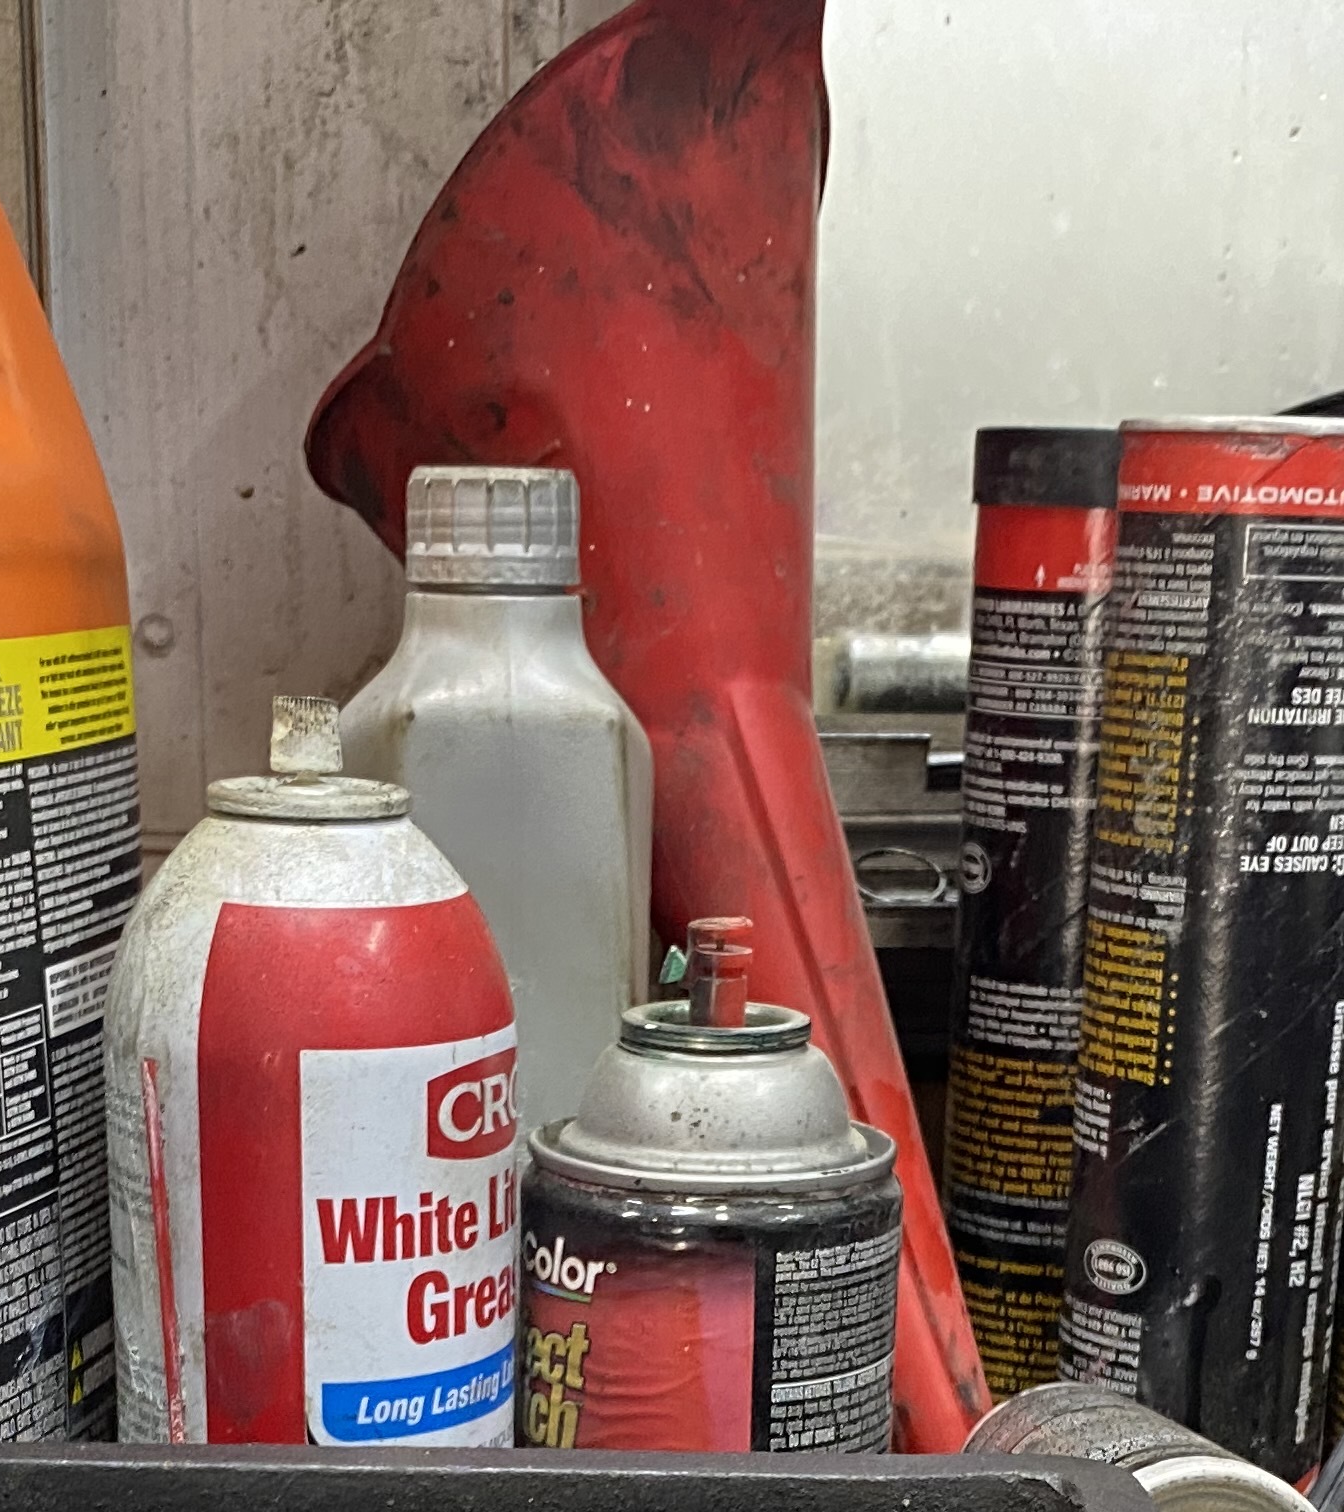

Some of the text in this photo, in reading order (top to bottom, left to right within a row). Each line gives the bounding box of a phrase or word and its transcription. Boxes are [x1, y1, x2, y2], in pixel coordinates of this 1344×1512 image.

[1248, 707, 1332, 725] IRRITATION
[1264, 833, 1319, 852] OUT OF
[1239, 855, 1329, 874] CAUSES EYE
[1268, 1103, 1284, 1132] NET
[1322, 1079, 1342, 1122] pour
[316, 1191, 480, 1265] White
[1288, 1173, 1316, 1288] NLGI #2, H2
[357, 1369, 500, 1427] Long Lasting
